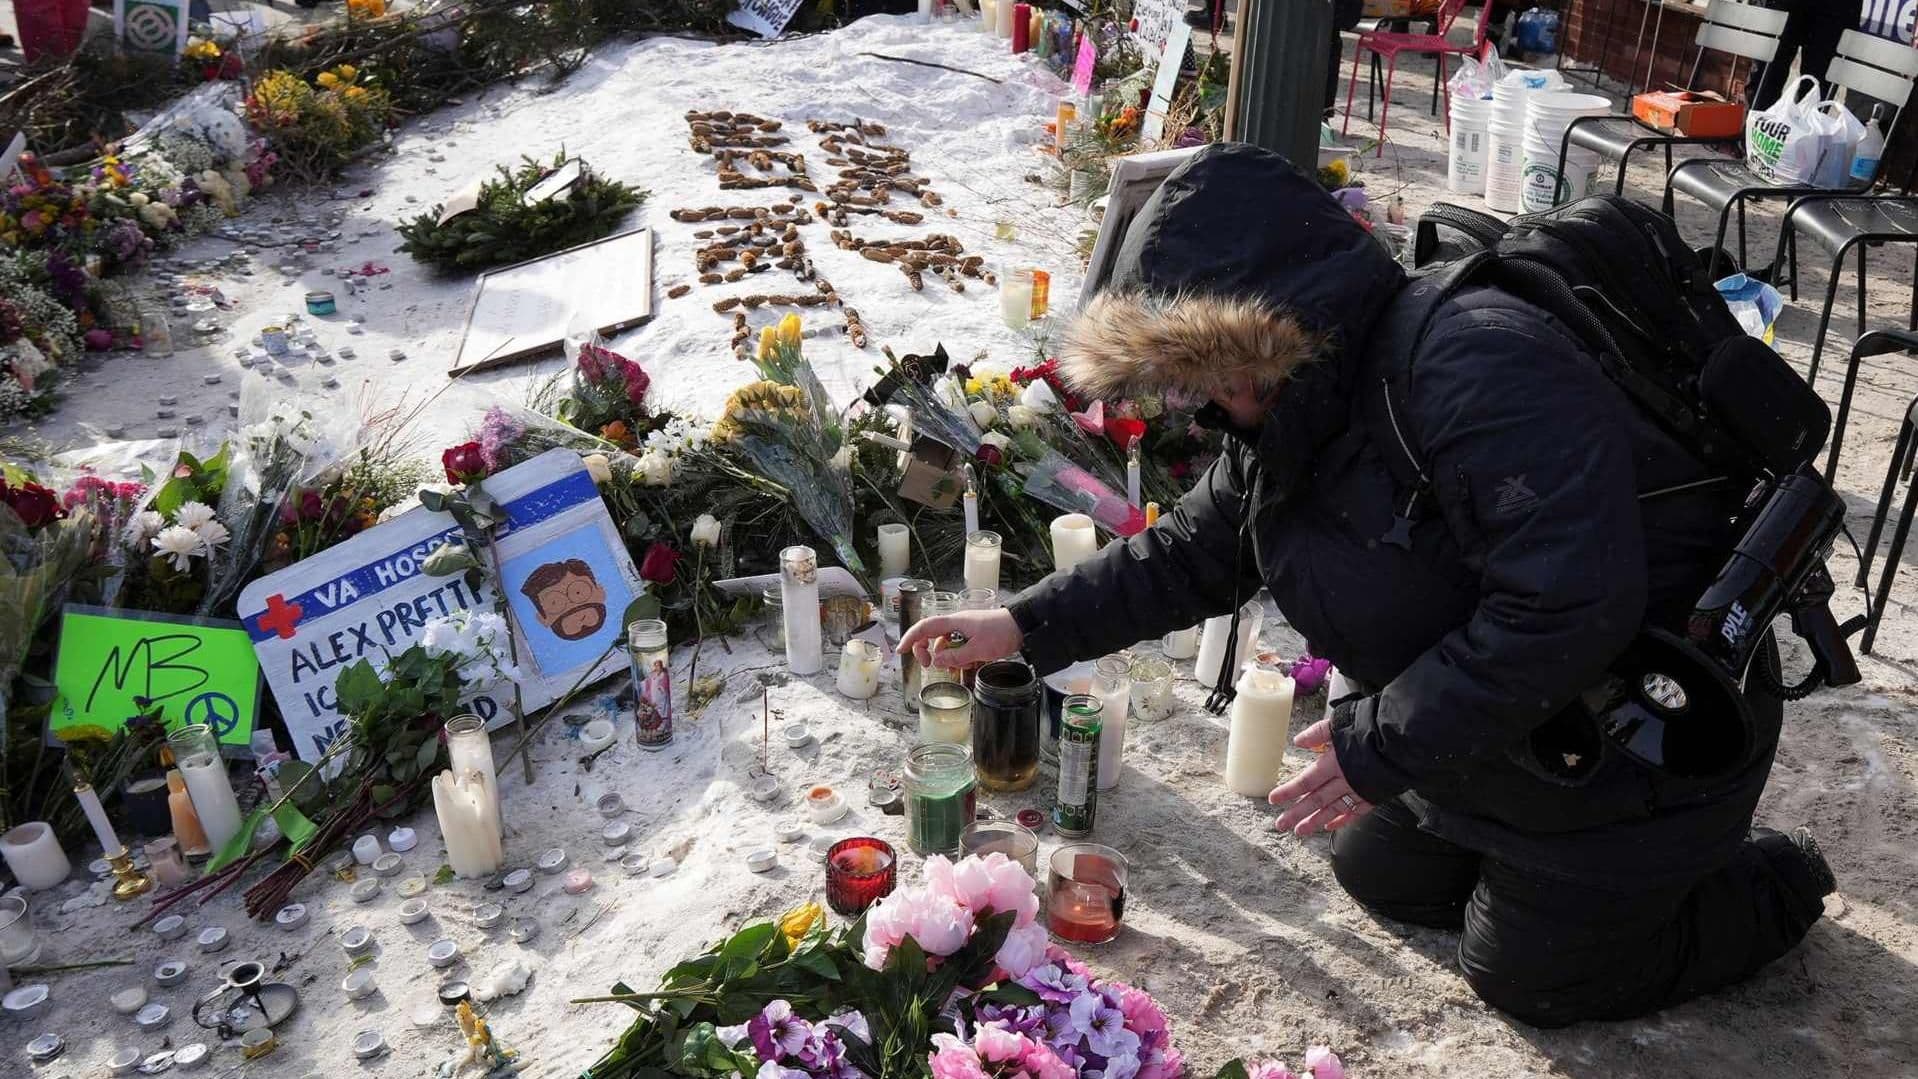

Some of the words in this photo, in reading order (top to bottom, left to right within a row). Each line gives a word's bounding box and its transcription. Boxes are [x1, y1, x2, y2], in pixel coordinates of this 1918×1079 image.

[1751, 128, 1784, 160] HOME
[313, 583, 358, 609] VA
[1720, 599, 1748, 644] PYLE
[291, 622, 378, 683] ALEX
